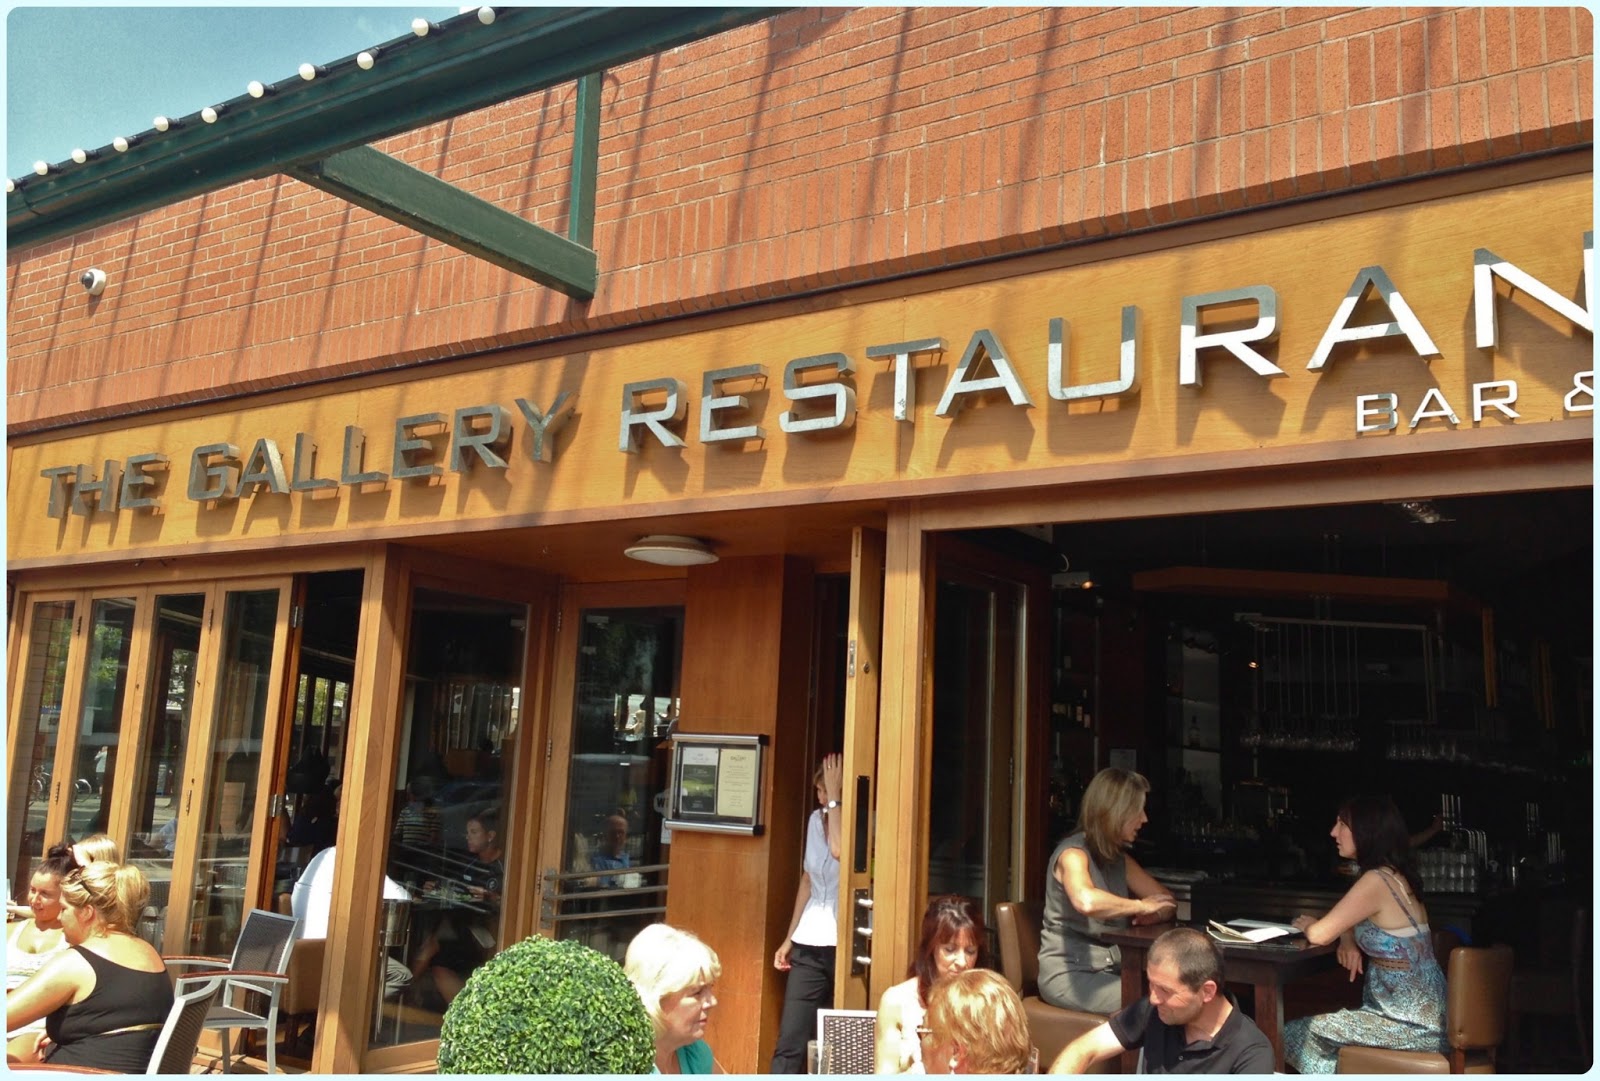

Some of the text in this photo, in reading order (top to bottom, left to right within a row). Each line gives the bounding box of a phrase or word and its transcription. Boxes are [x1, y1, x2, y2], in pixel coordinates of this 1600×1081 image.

[1356, 379, 1521, 433] BAR
[40, 452, 168, 519] THE
[187, 391, 577, 501] GALLERY
